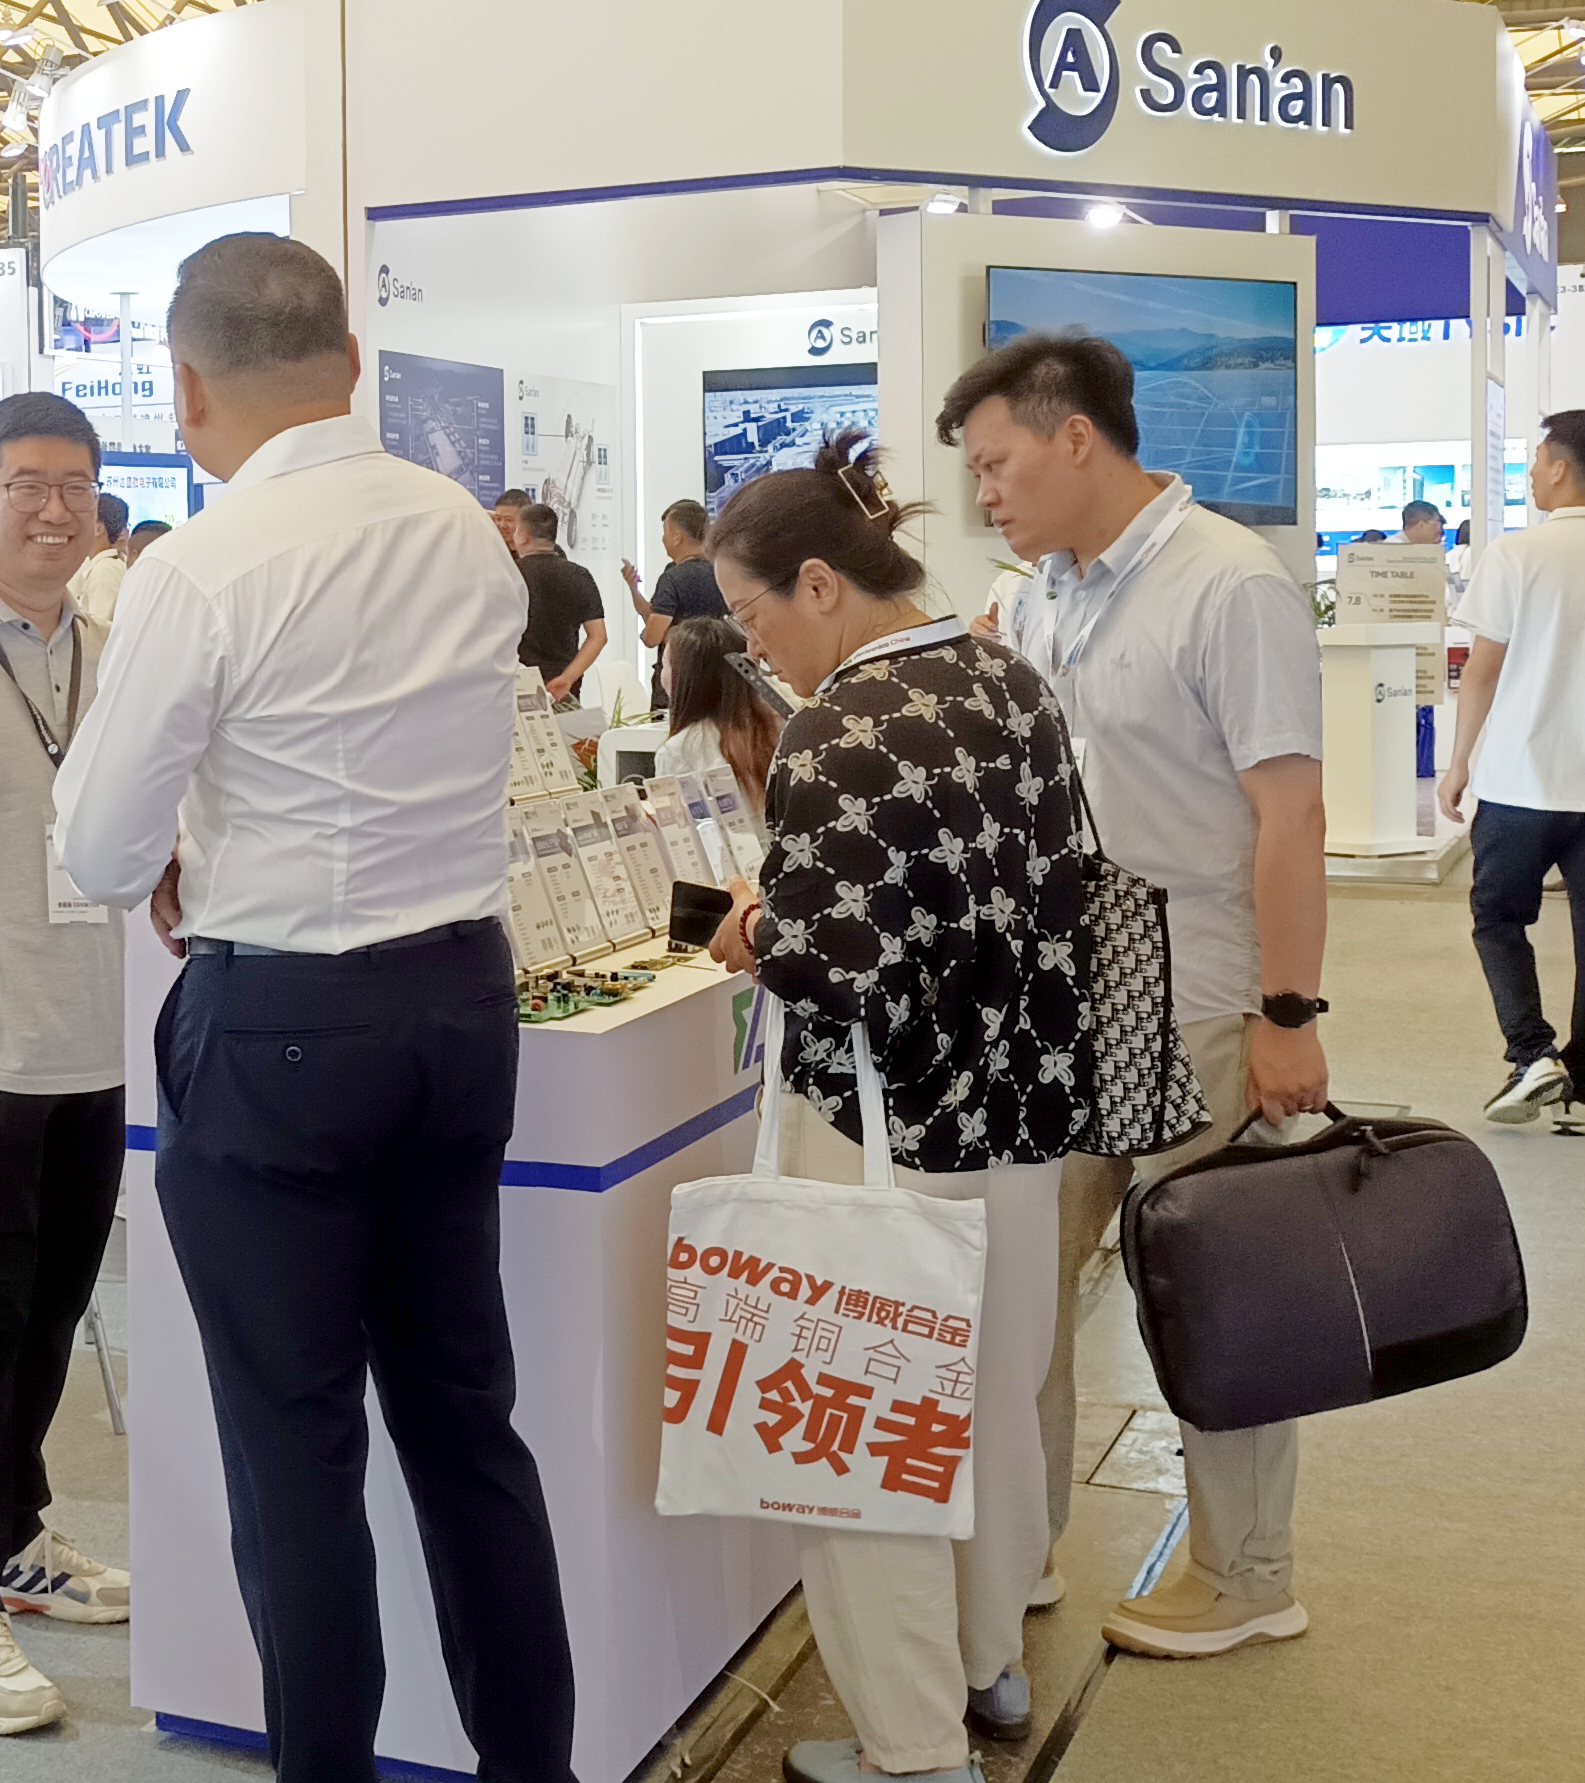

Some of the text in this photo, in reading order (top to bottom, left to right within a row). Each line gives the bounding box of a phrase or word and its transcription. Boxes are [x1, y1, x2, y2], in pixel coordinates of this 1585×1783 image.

[1135, 30, 1354, 132] San'an
[61, 379, 154, 398] FeiHong
[1369, 570, 1415, 579] TIME TABLE
[667, 1236, 973, 1349] boway 博威合金
[662, 1325, 973, 1505] 引领者
[759, 1498, 816, 1515] boway
